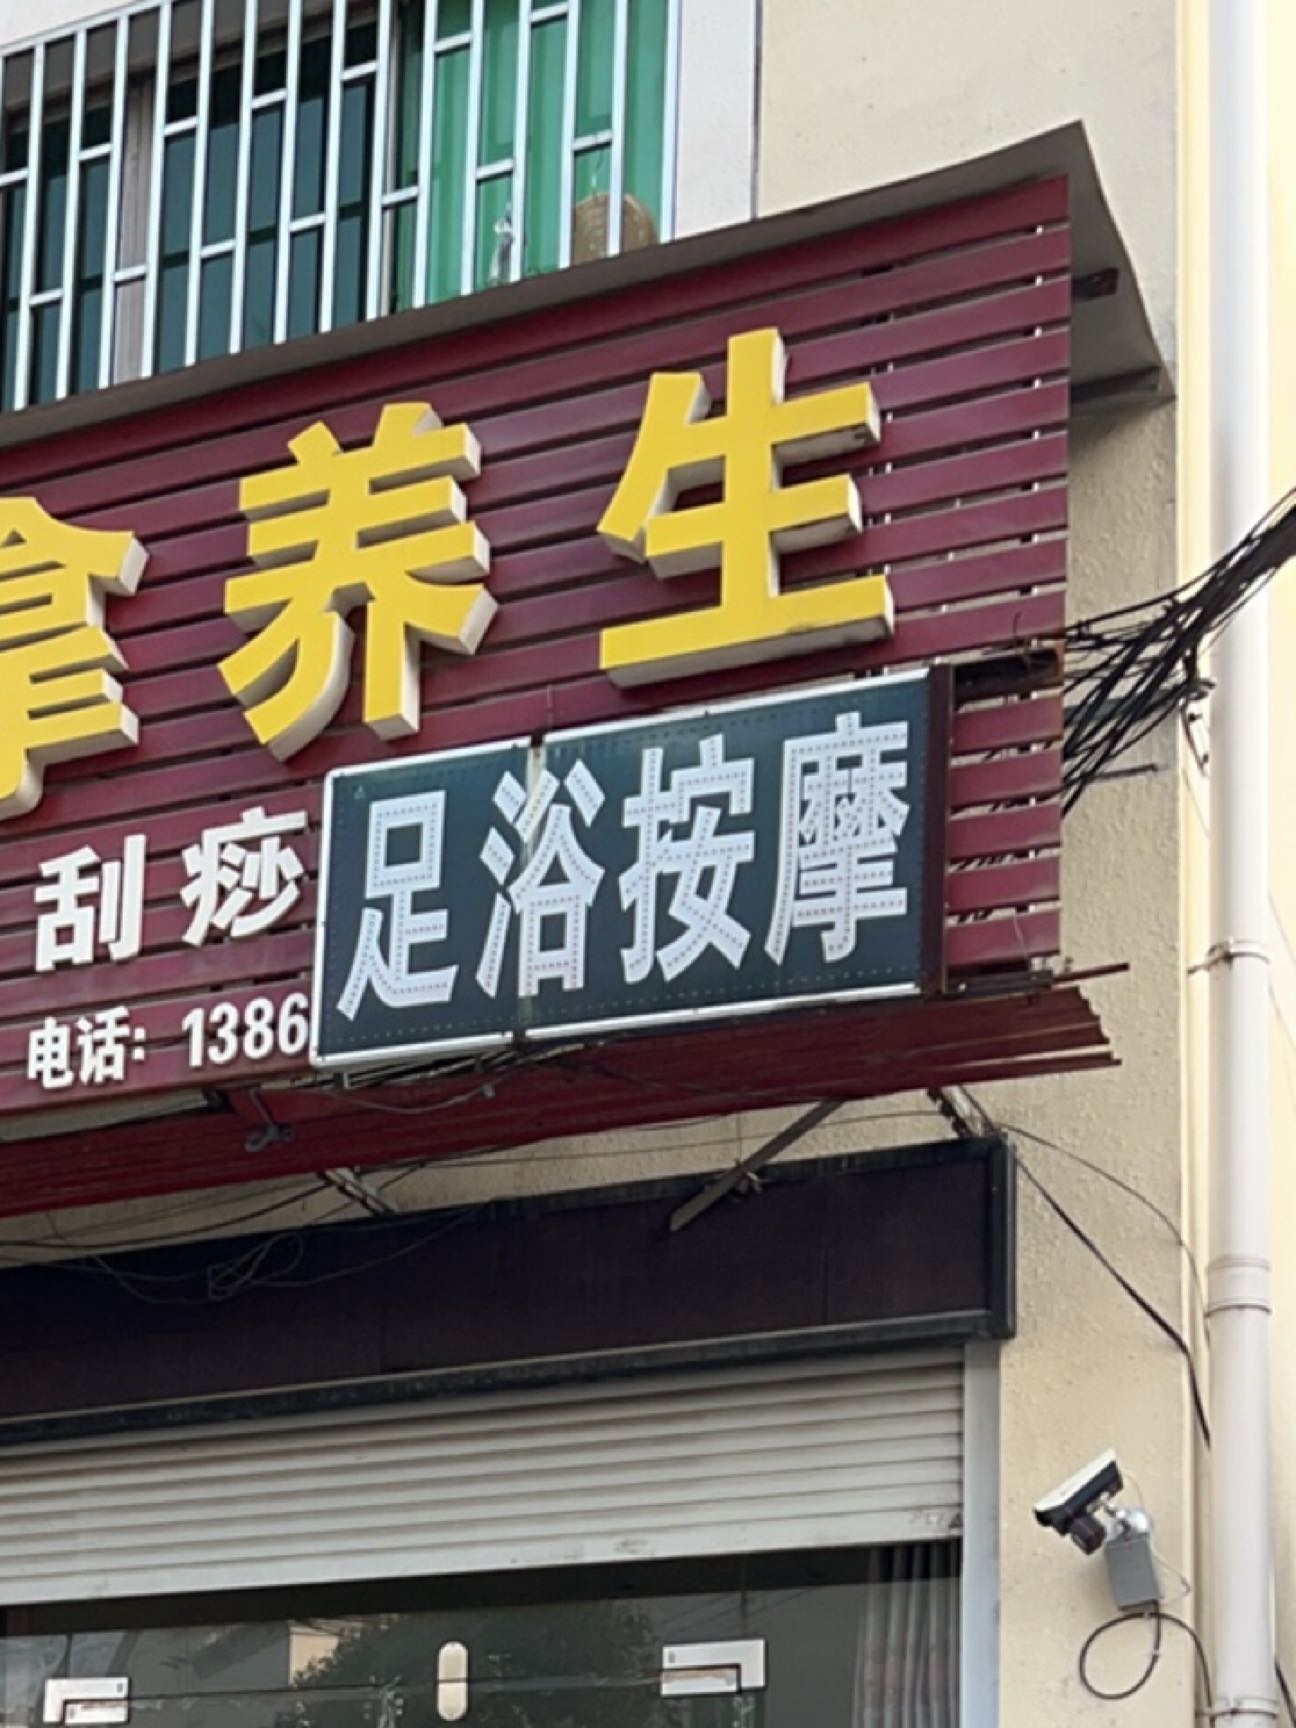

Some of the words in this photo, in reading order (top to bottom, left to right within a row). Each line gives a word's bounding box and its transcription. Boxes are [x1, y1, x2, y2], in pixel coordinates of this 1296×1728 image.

[34, 805, 308, 973] 刮痧
[336, 711, 910, 1018] 足浴按摩
